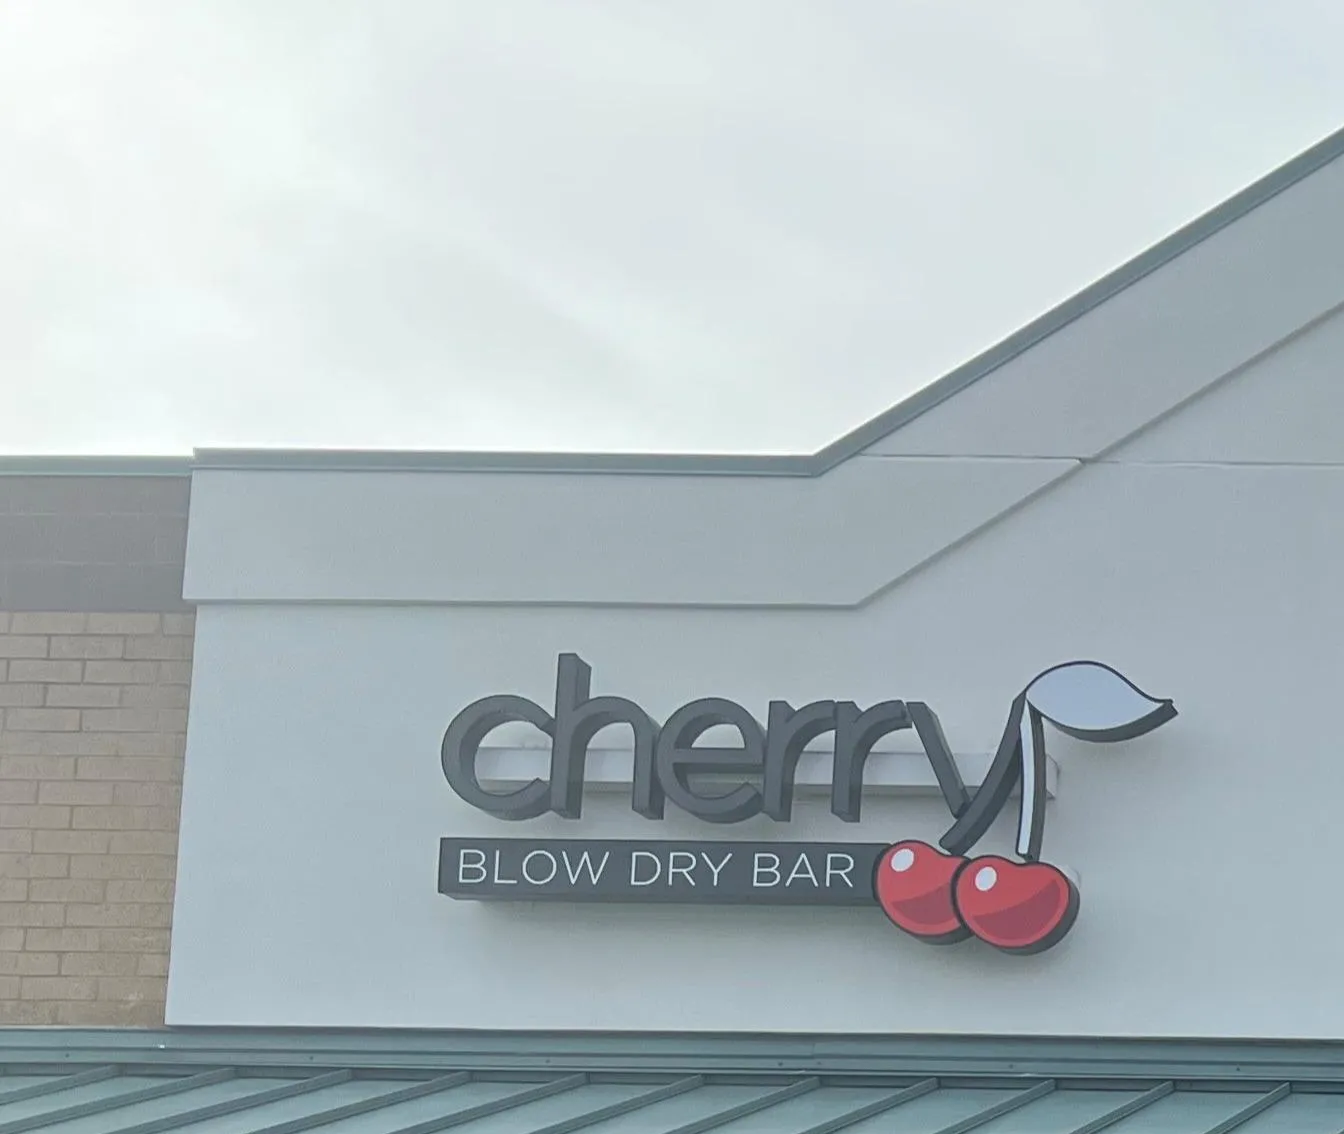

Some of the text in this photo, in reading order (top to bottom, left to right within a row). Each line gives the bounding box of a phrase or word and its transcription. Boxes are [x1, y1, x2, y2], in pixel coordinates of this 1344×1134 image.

[441, 653, 1027, 853] cherry
[458, 850, 855, 888] BLOW DRY BAR
